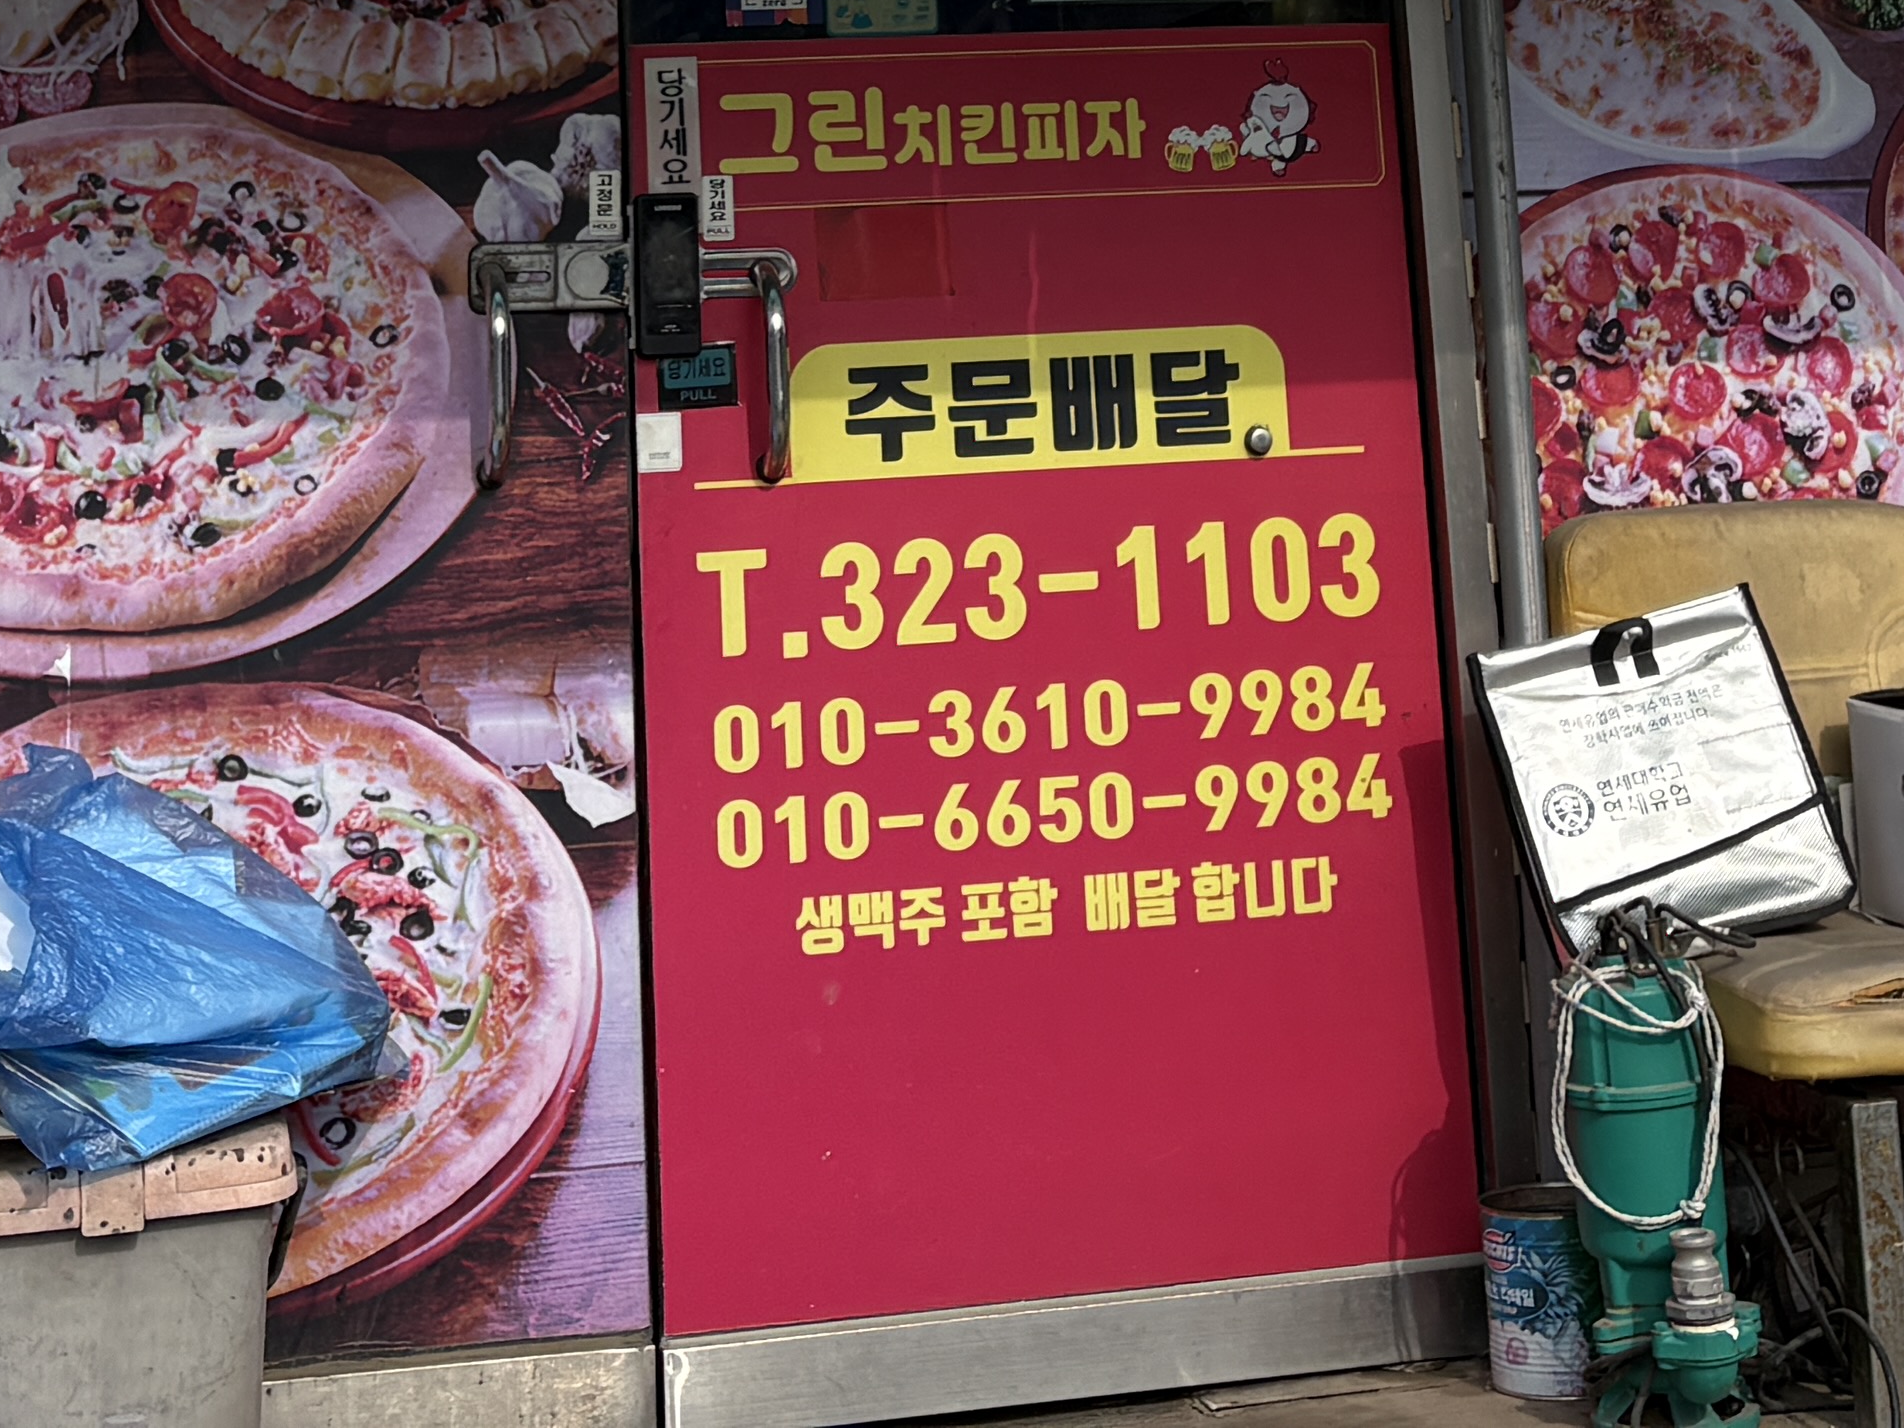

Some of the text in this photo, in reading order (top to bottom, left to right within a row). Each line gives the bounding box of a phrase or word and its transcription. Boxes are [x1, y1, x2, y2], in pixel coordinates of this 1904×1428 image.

[657, 68, 691, 185] 당기세요
[709, 178, 727, 222] 당기세요
[680, 389, 717, 401] PULL
[845, 348, 1241, 463] 주문배달
[696, 511, 1381, 659] T.323-1103
[712, 662, 1386, 774] 010-3610-9984
[716, 753, 1394, 869] 010-6650-9984
[1604, 783, 1691, 822] 연세유업
[796, 856, 1338, 955] 생맥주 포함 배달 합니다
